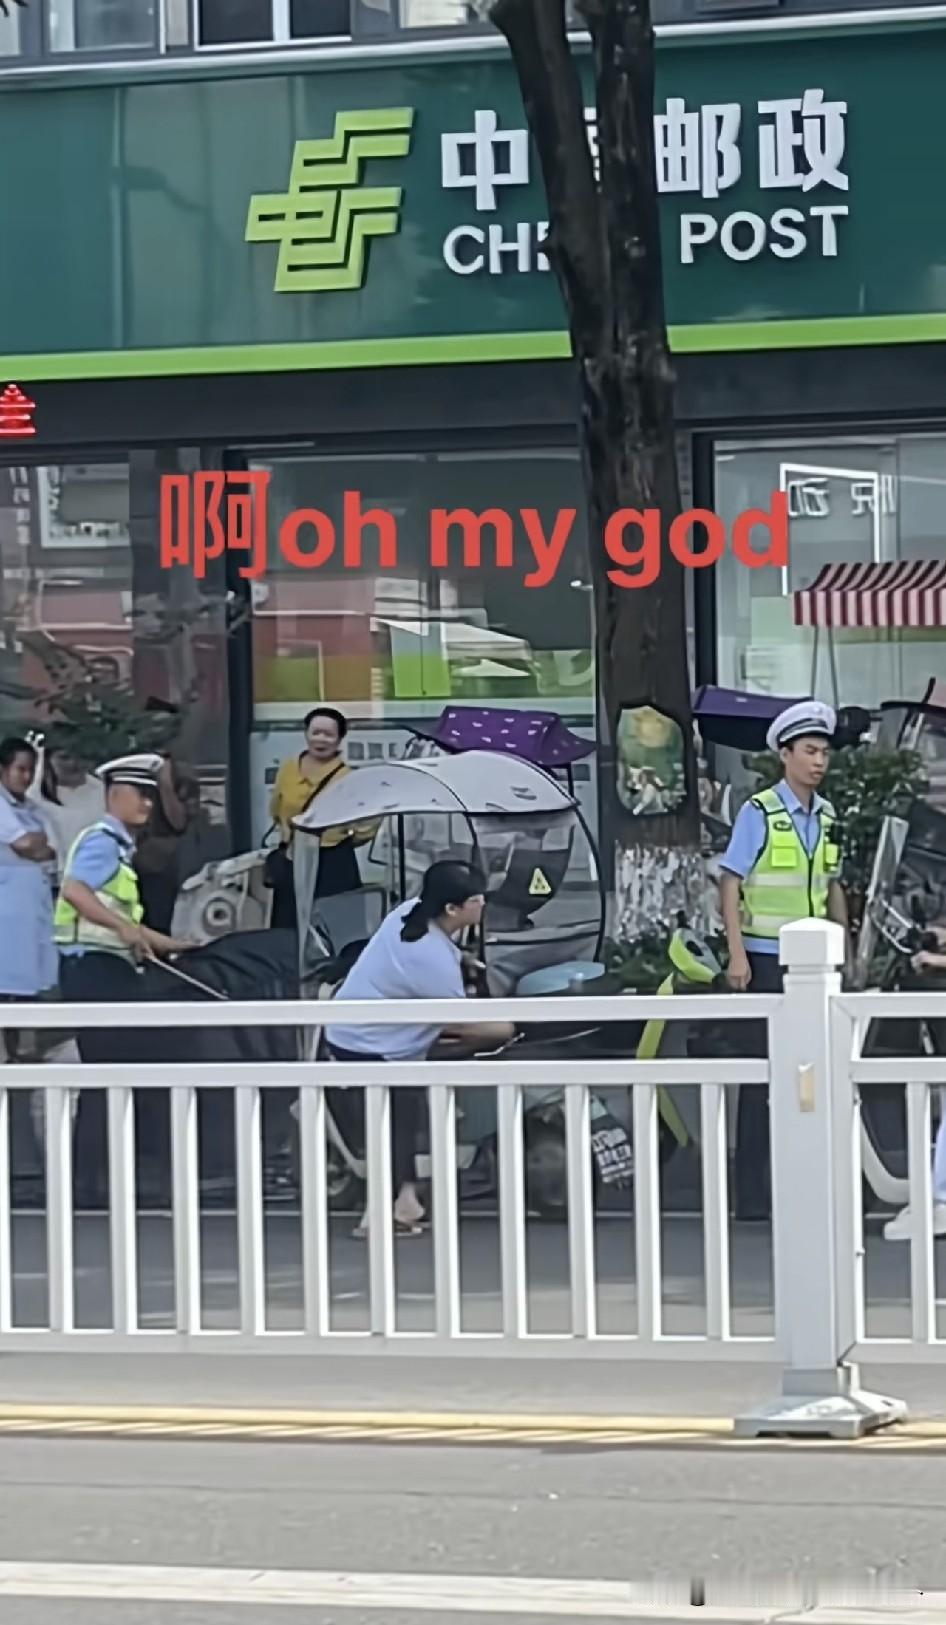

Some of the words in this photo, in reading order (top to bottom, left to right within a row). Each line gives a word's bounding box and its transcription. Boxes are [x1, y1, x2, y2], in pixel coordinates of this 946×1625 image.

[442, 90, 849, 210] 中邮政
[681, 206, 849, 264] POST
